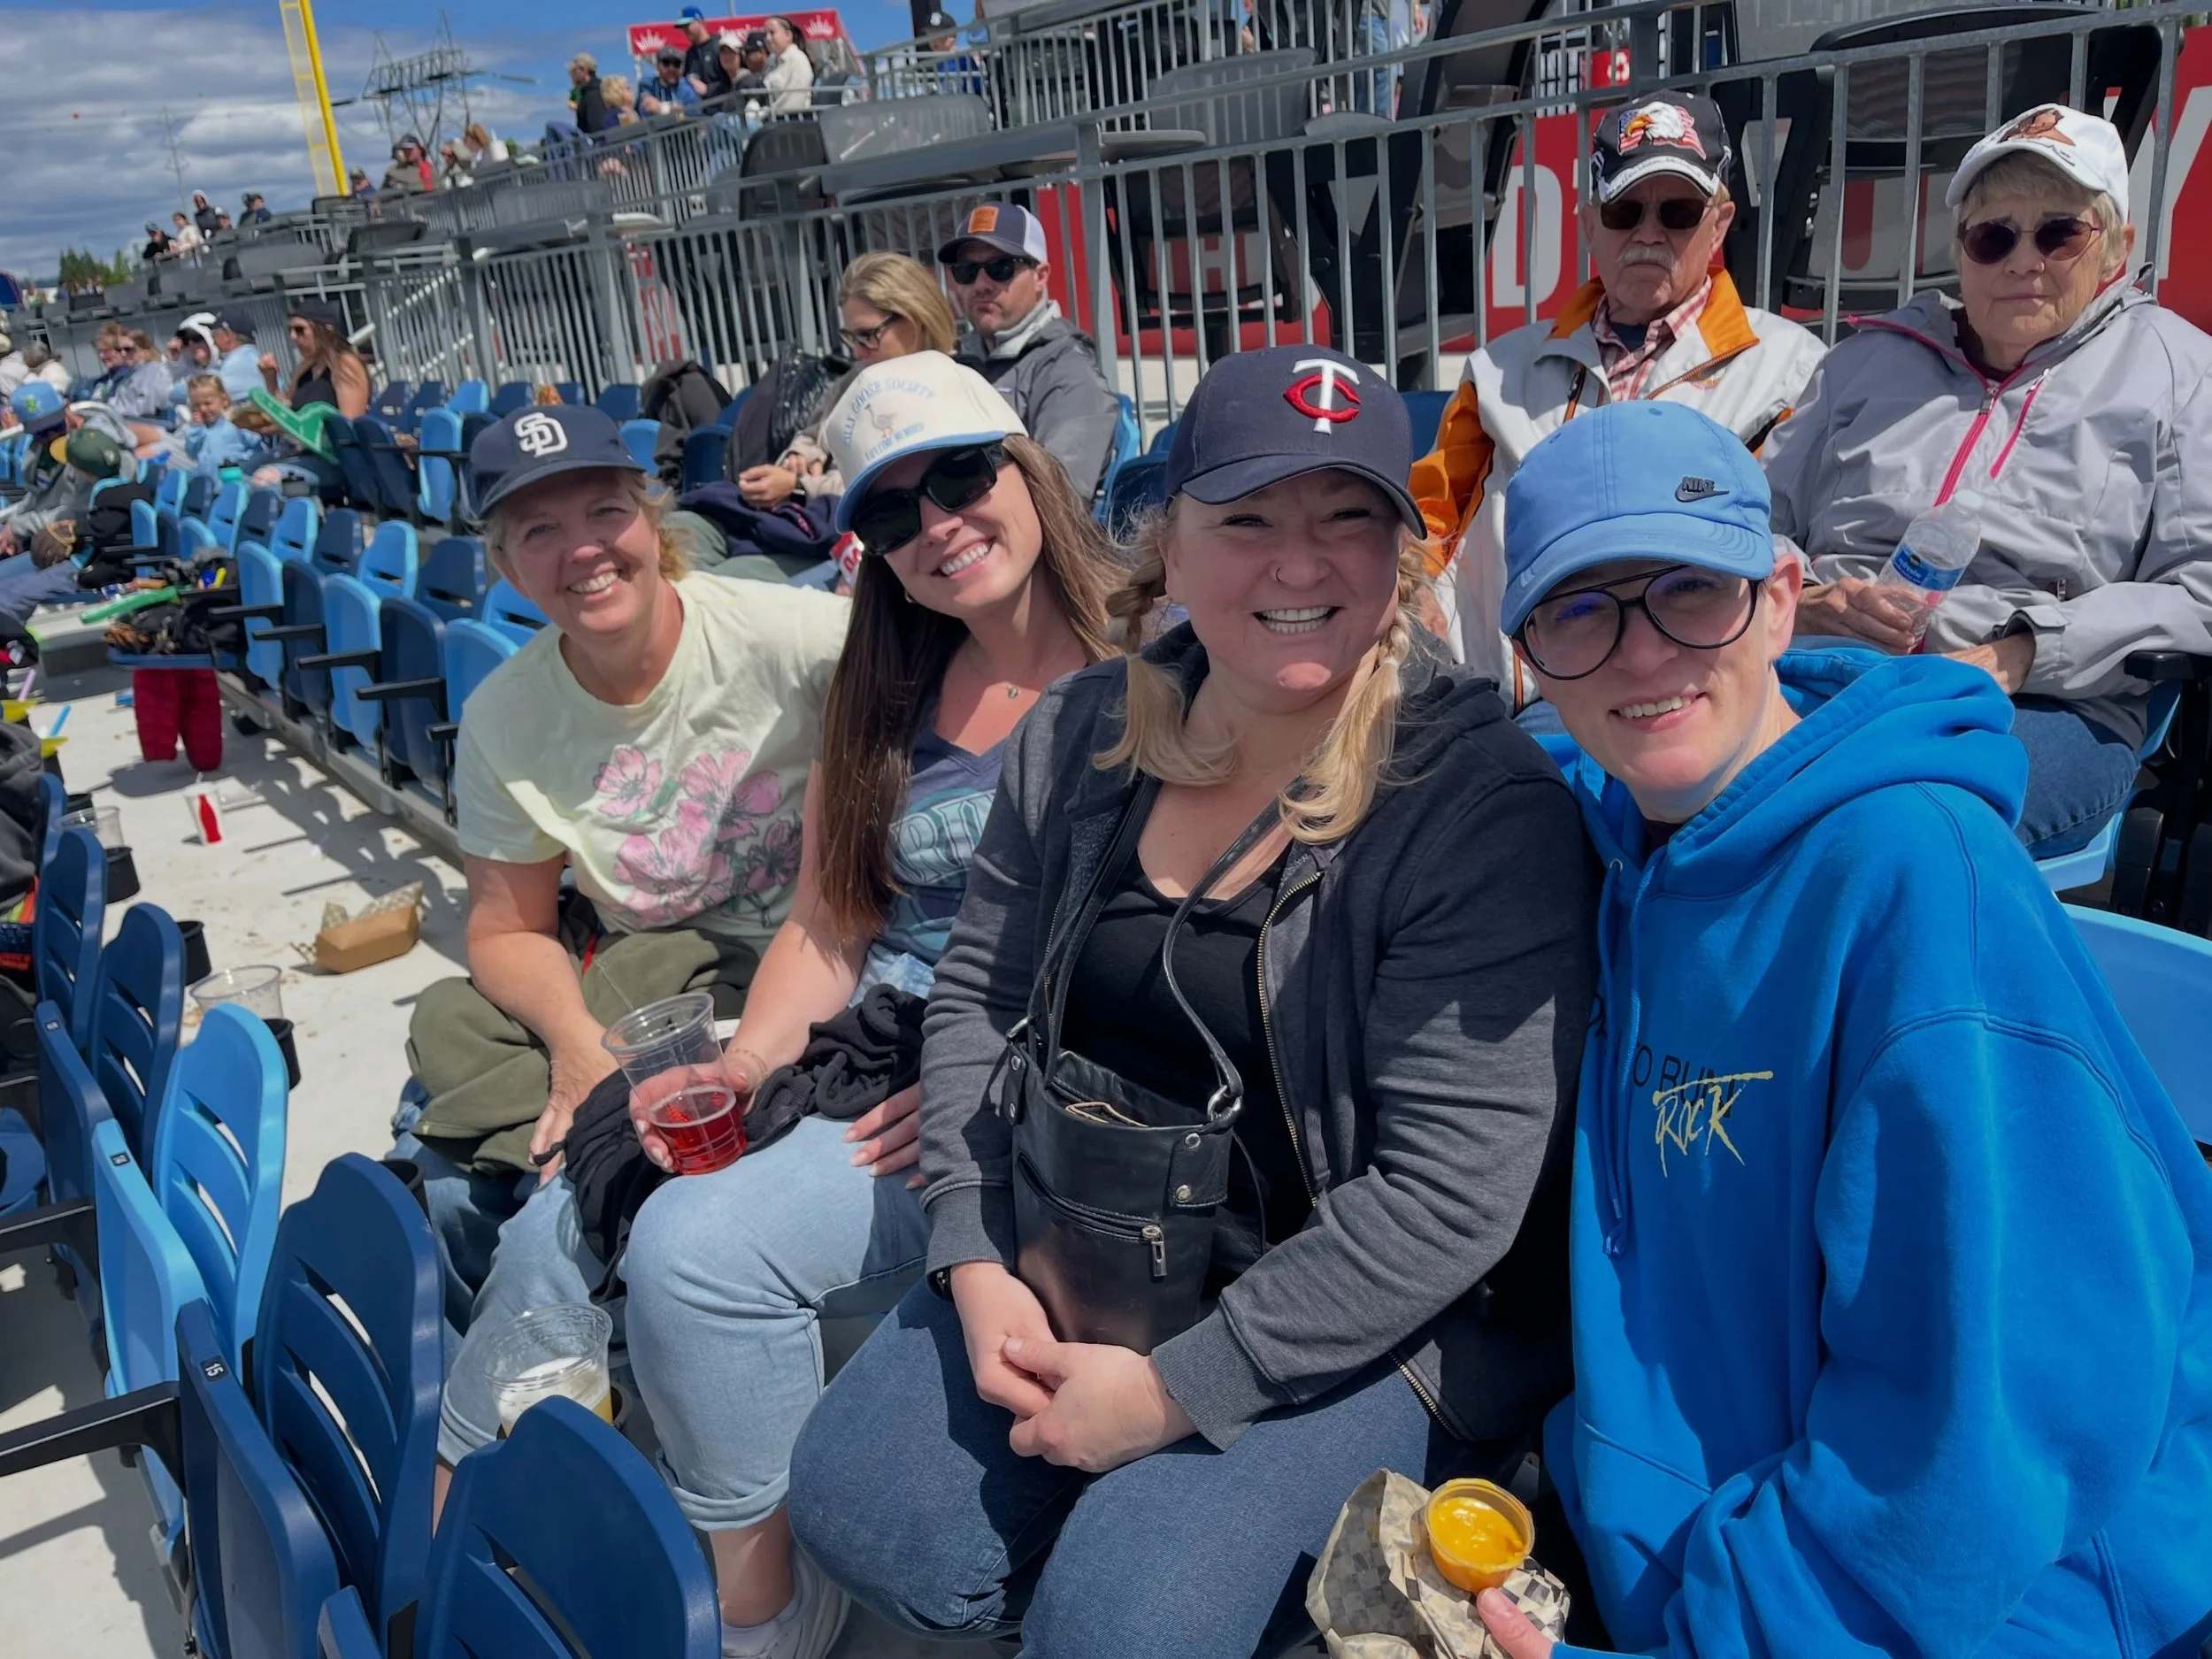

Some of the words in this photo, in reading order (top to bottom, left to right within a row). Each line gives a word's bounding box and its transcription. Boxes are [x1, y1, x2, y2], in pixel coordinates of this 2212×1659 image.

[851, 380, 881, 415] GOOSE
[884, 377, 936, 401] SOCIETY
[513, 411, 568, 458] SD
[1681, 475, 1715, 493] NIKE
[204, 1363, 224, 1378] 15
